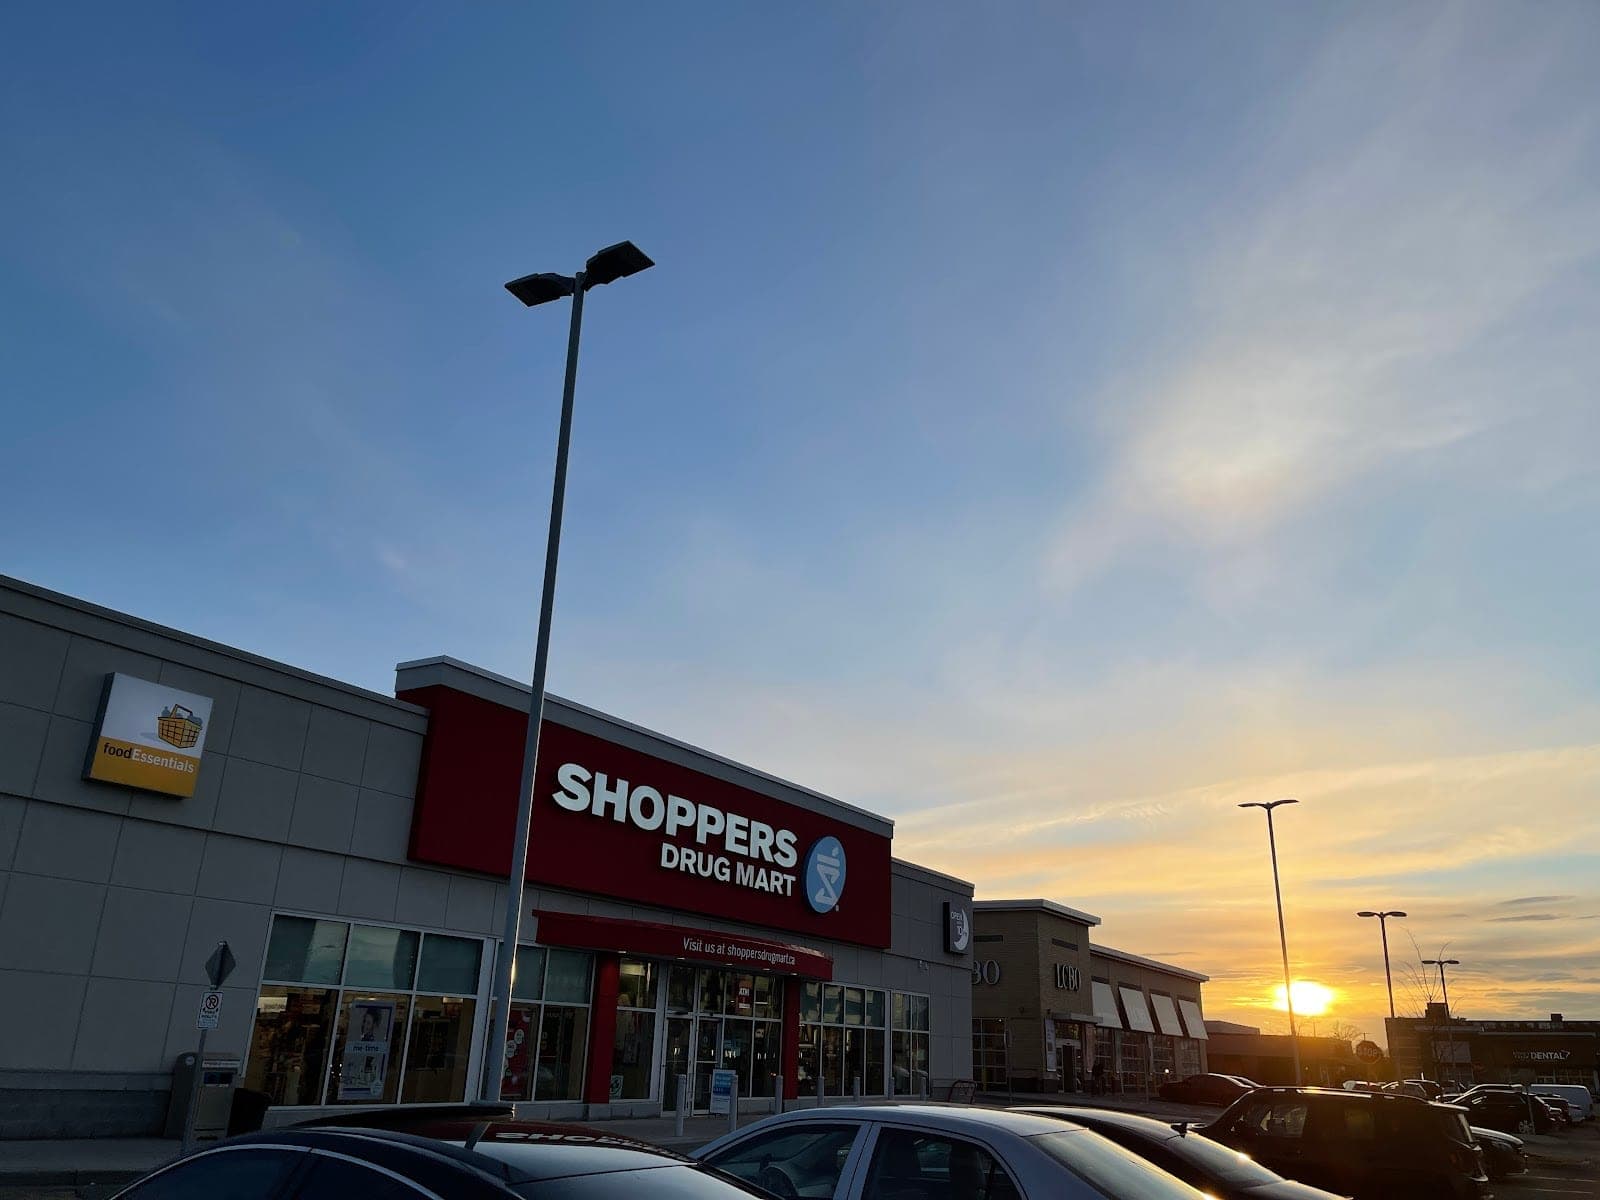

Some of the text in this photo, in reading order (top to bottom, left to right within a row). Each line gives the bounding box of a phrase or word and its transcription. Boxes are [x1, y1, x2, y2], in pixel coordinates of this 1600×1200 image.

[552, 763, 798, 868] SHOPPERS
[660, 843, 797, 897] DRUG MART
[683, 937, 702, 952] Visit
[704, 943, 715, 954] us
[716, 943, 725, 955] at
[971, 960, 1000, 985] BO
[1056, 962, 1082, 992] LCBO
[1530, 1051, 1566, 1061] DENTAL
